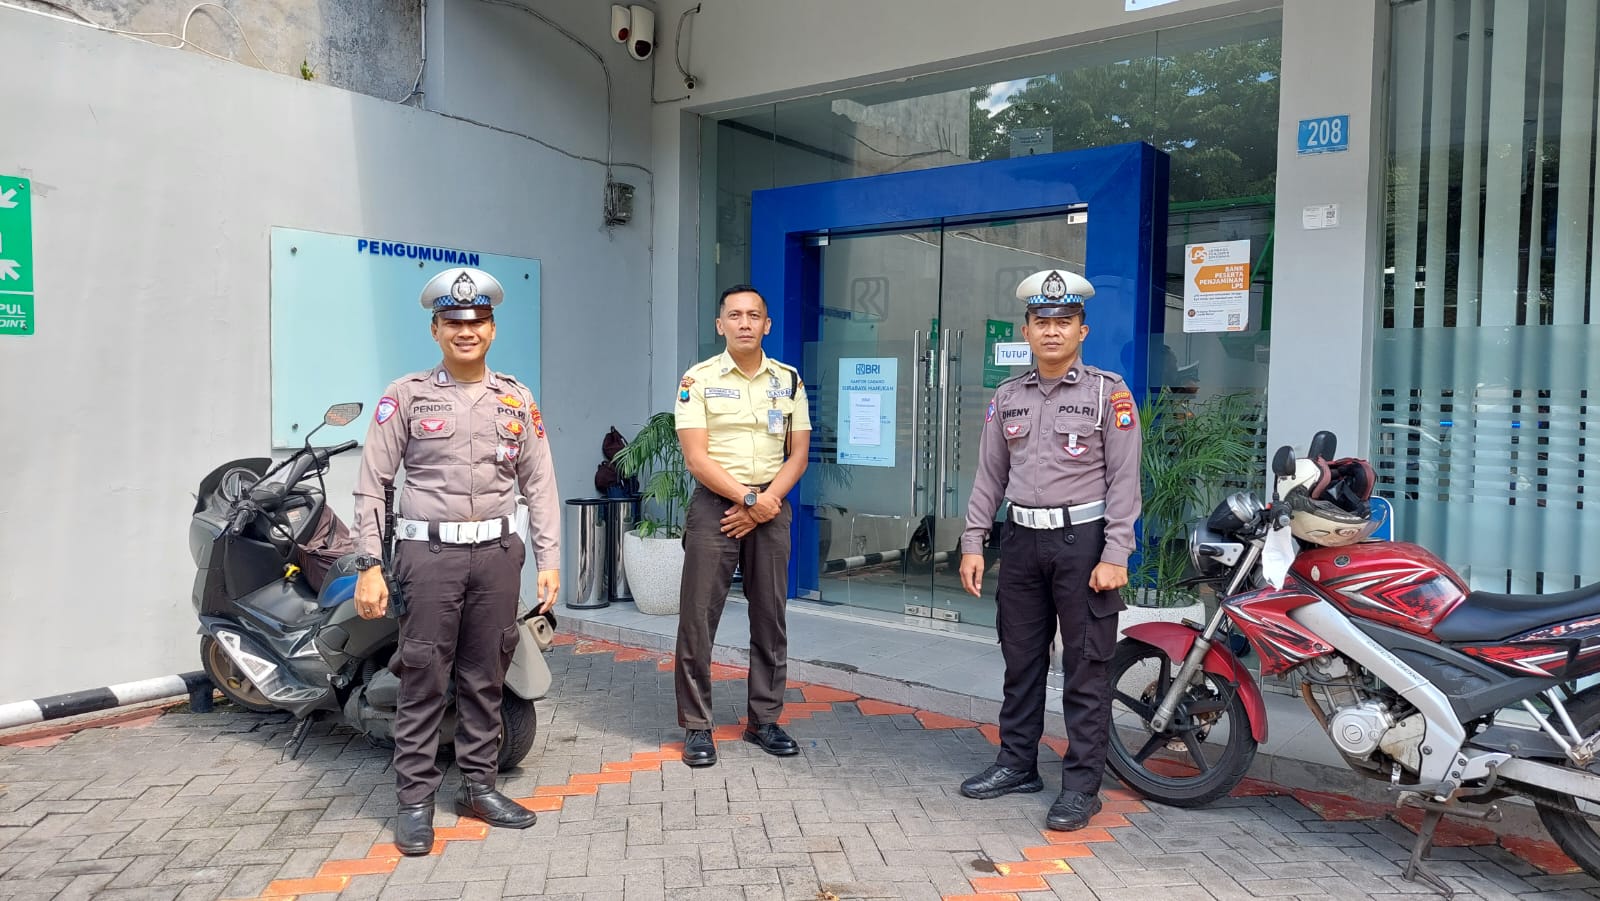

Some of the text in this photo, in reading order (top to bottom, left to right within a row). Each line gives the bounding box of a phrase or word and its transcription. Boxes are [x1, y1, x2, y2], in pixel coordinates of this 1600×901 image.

[1307, 118, 1341, 146] 208
[357, 239, 479, 266] PENGUMUMAN
[1001, 350, 1028, 358] TUTUP
[865, 364, 881, 375] BRI
[413, 405, 453, 414] PENDIG
[1002, 408, 1030, 420] DHENY
[1058, 405, 1095, 417] POLRI
